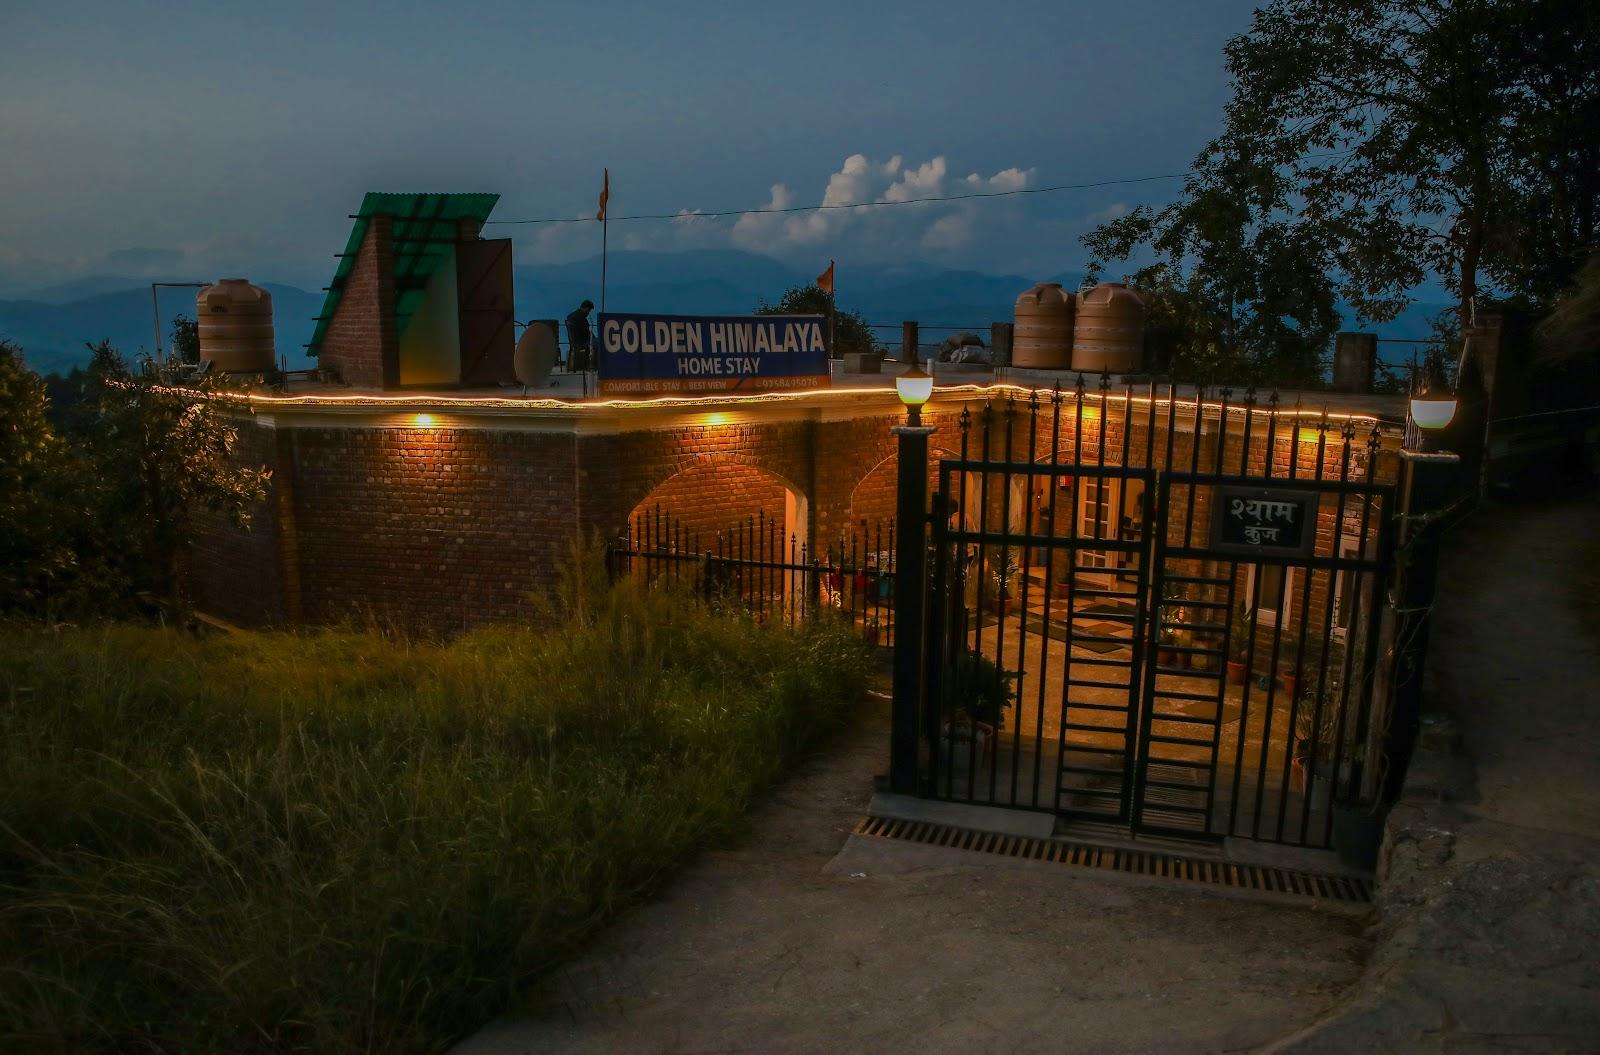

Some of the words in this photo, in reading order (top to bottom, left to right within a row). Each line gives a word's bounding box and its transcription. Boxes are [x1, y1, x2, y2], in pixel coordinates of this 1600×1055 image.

[603, 319, 703, 353] GOLDEN
[709, 322, 825, 353] HIMALAYA
[678, 357, 721, 375] HOME
[726, 357, 760, 374] STAY
[662, 381, 680, 391] STAY
[688, 380, 707, 391] BEST
[708, 380, 727, 390] VIEW
[1231, 499, 1297, 523] श्याम
